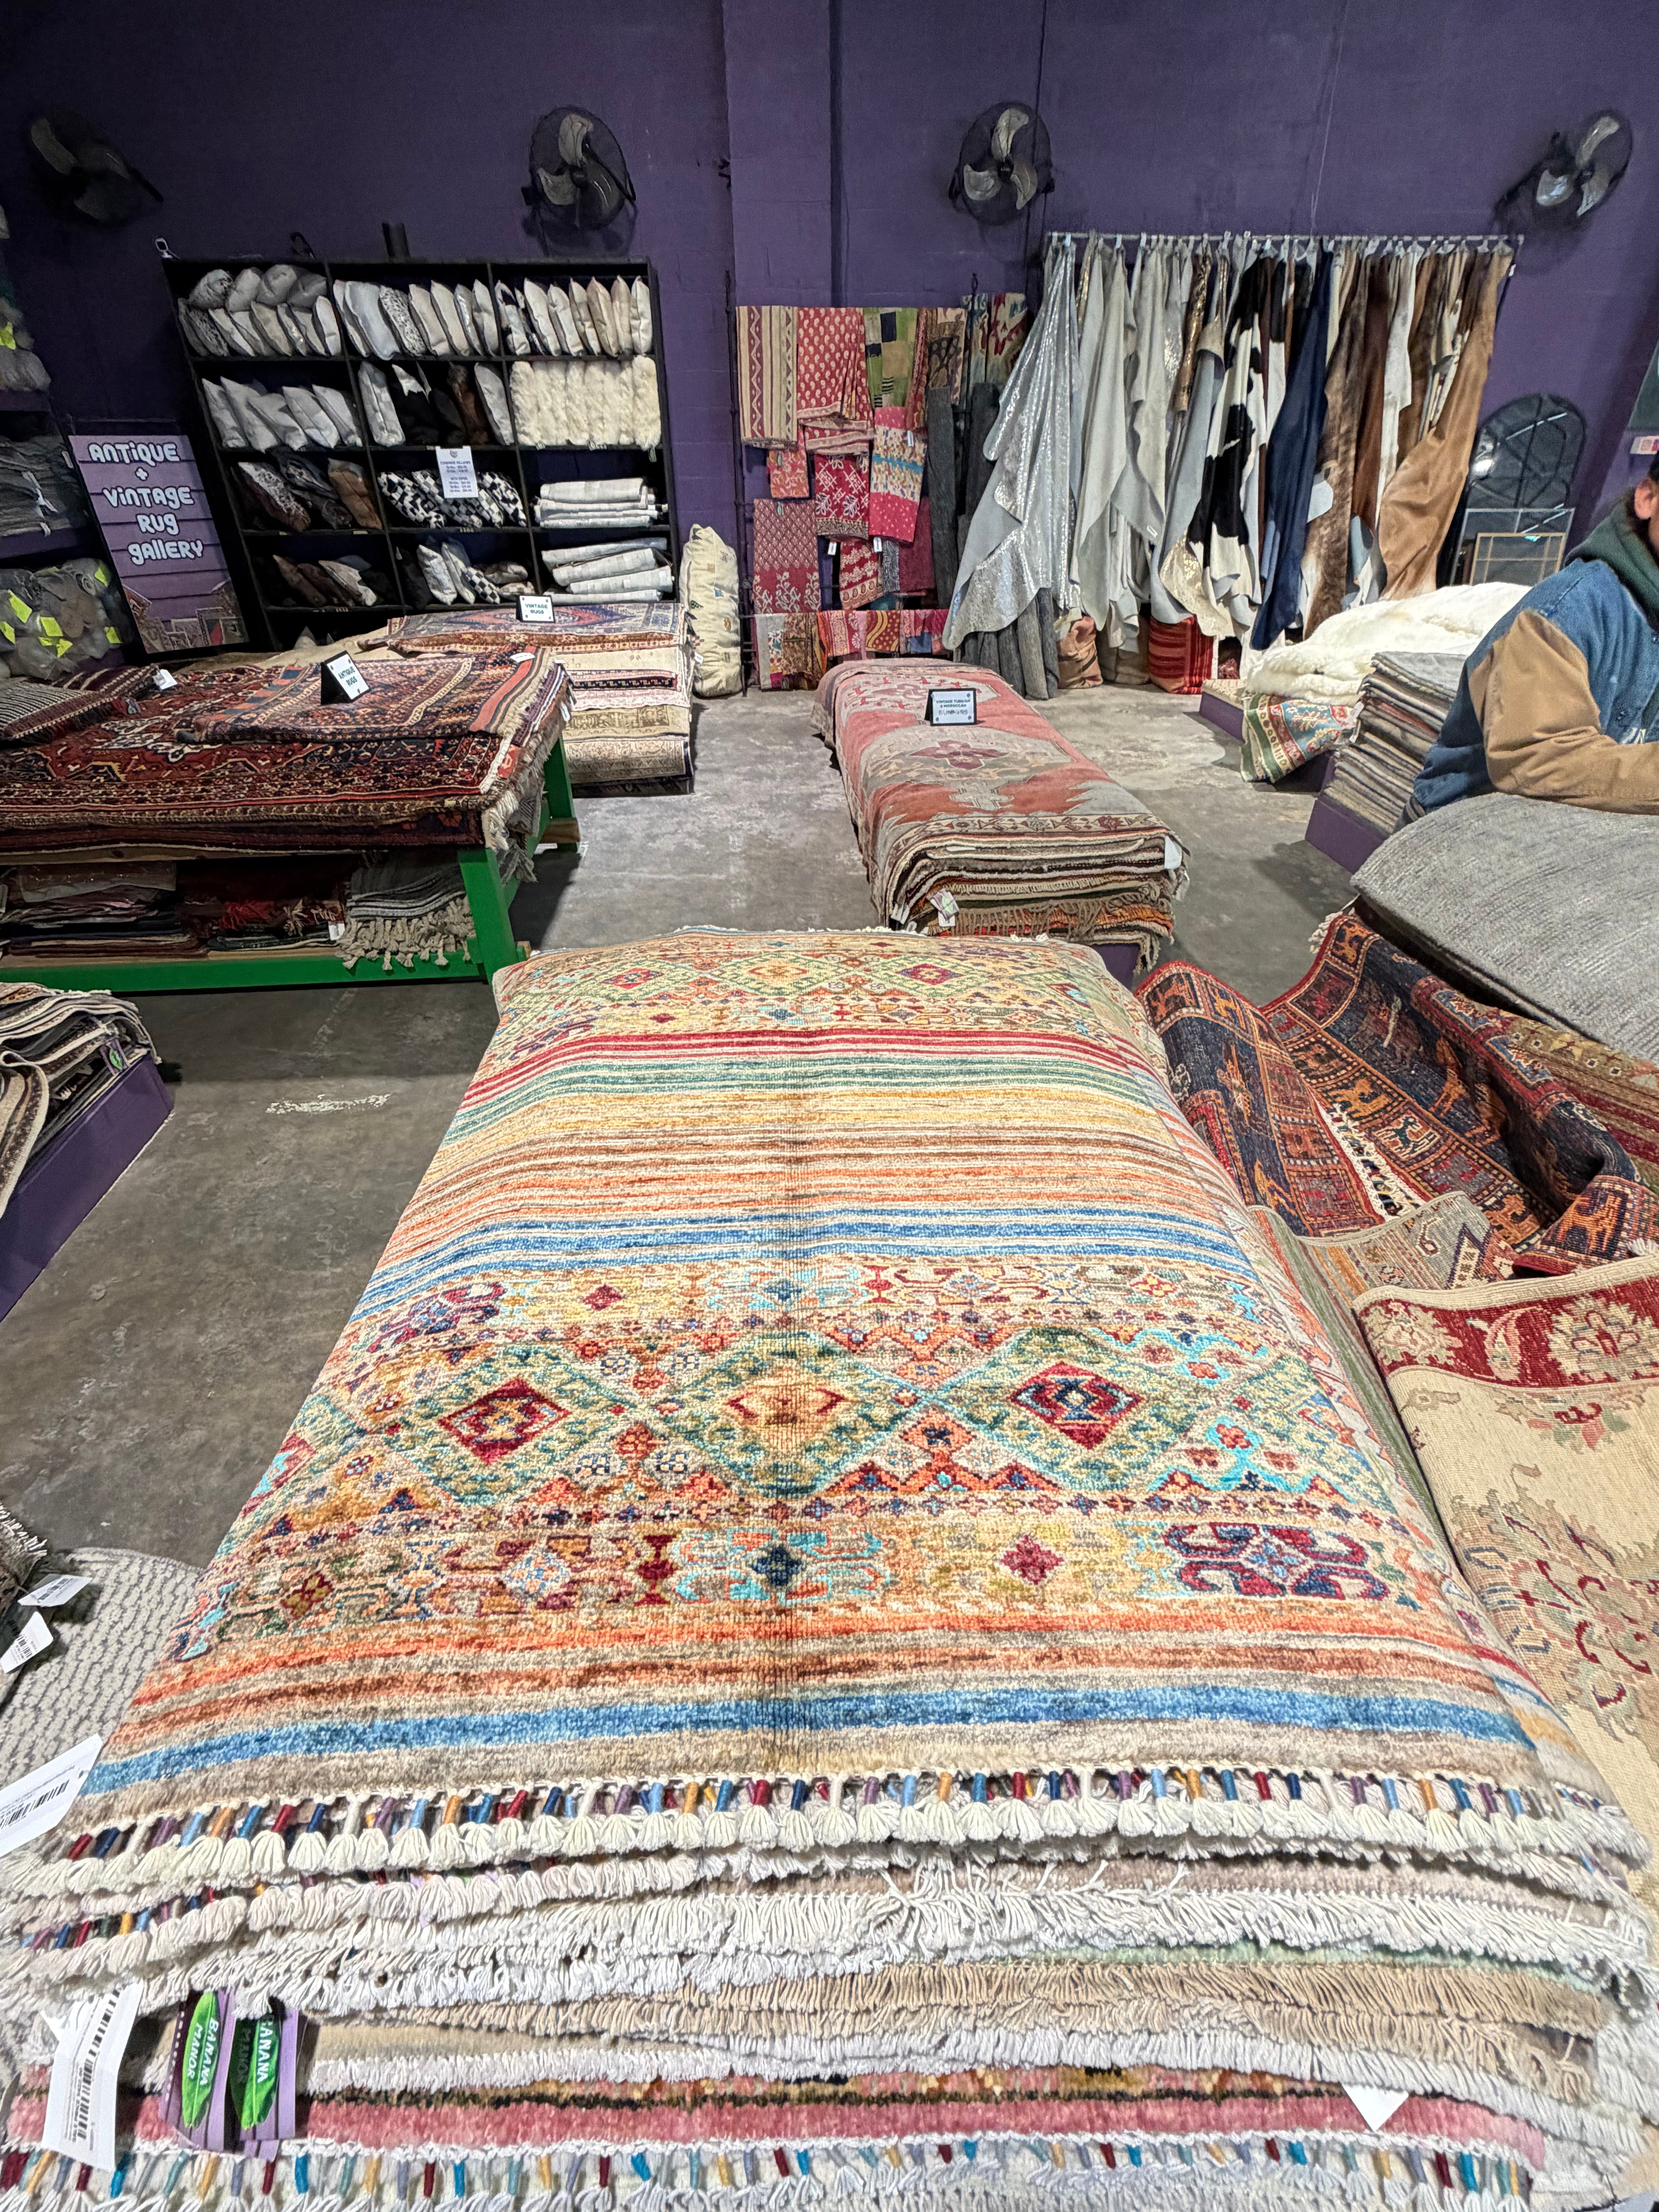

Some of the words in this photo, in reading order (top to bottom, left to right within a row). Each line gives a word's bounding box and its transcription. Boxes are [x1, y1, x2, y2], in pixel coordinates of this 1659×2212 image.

[135, 467, 149, 481] +
[338, 666, 356, 679] ANTIQUE
[346, 676, 357, 686] RUGS
[187, 2022, 203, 2080] MANOR
[199, 2017, 220, 2086] BANANA
